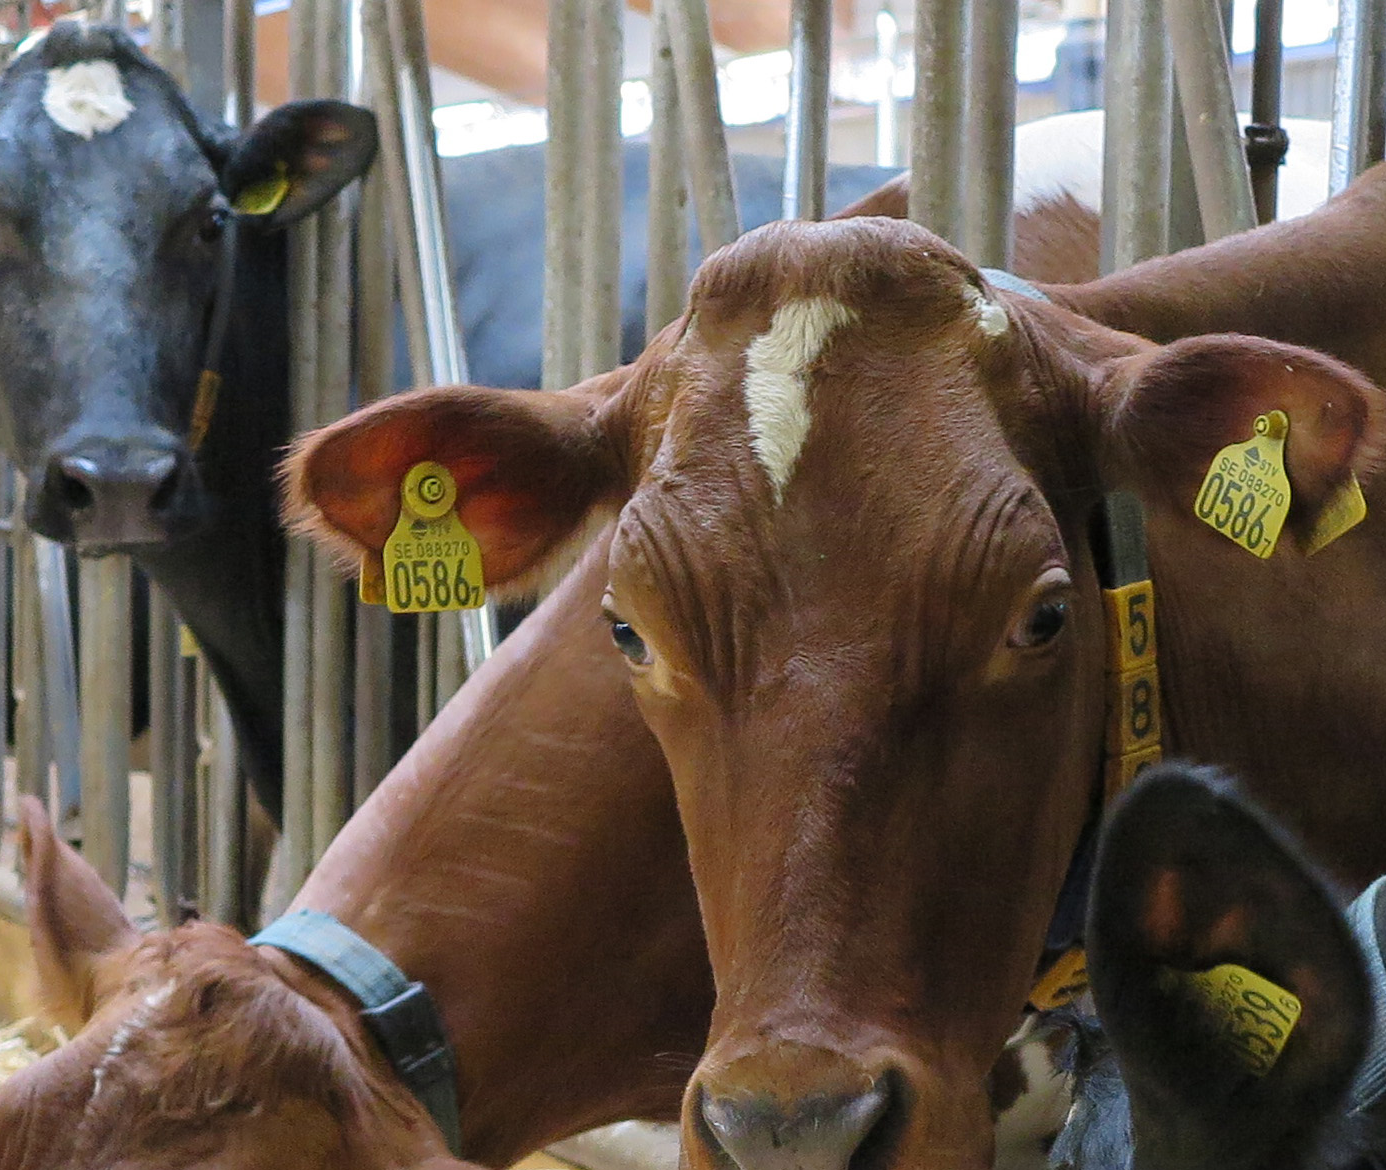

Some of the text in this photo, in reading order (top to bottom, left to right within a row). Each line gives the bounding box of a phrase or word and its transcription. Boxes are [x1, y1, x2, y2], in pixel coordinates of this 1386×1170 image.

[1219, 457, 1285, 507] SE 088270
[394, 541, 470, 560] SE 088270
